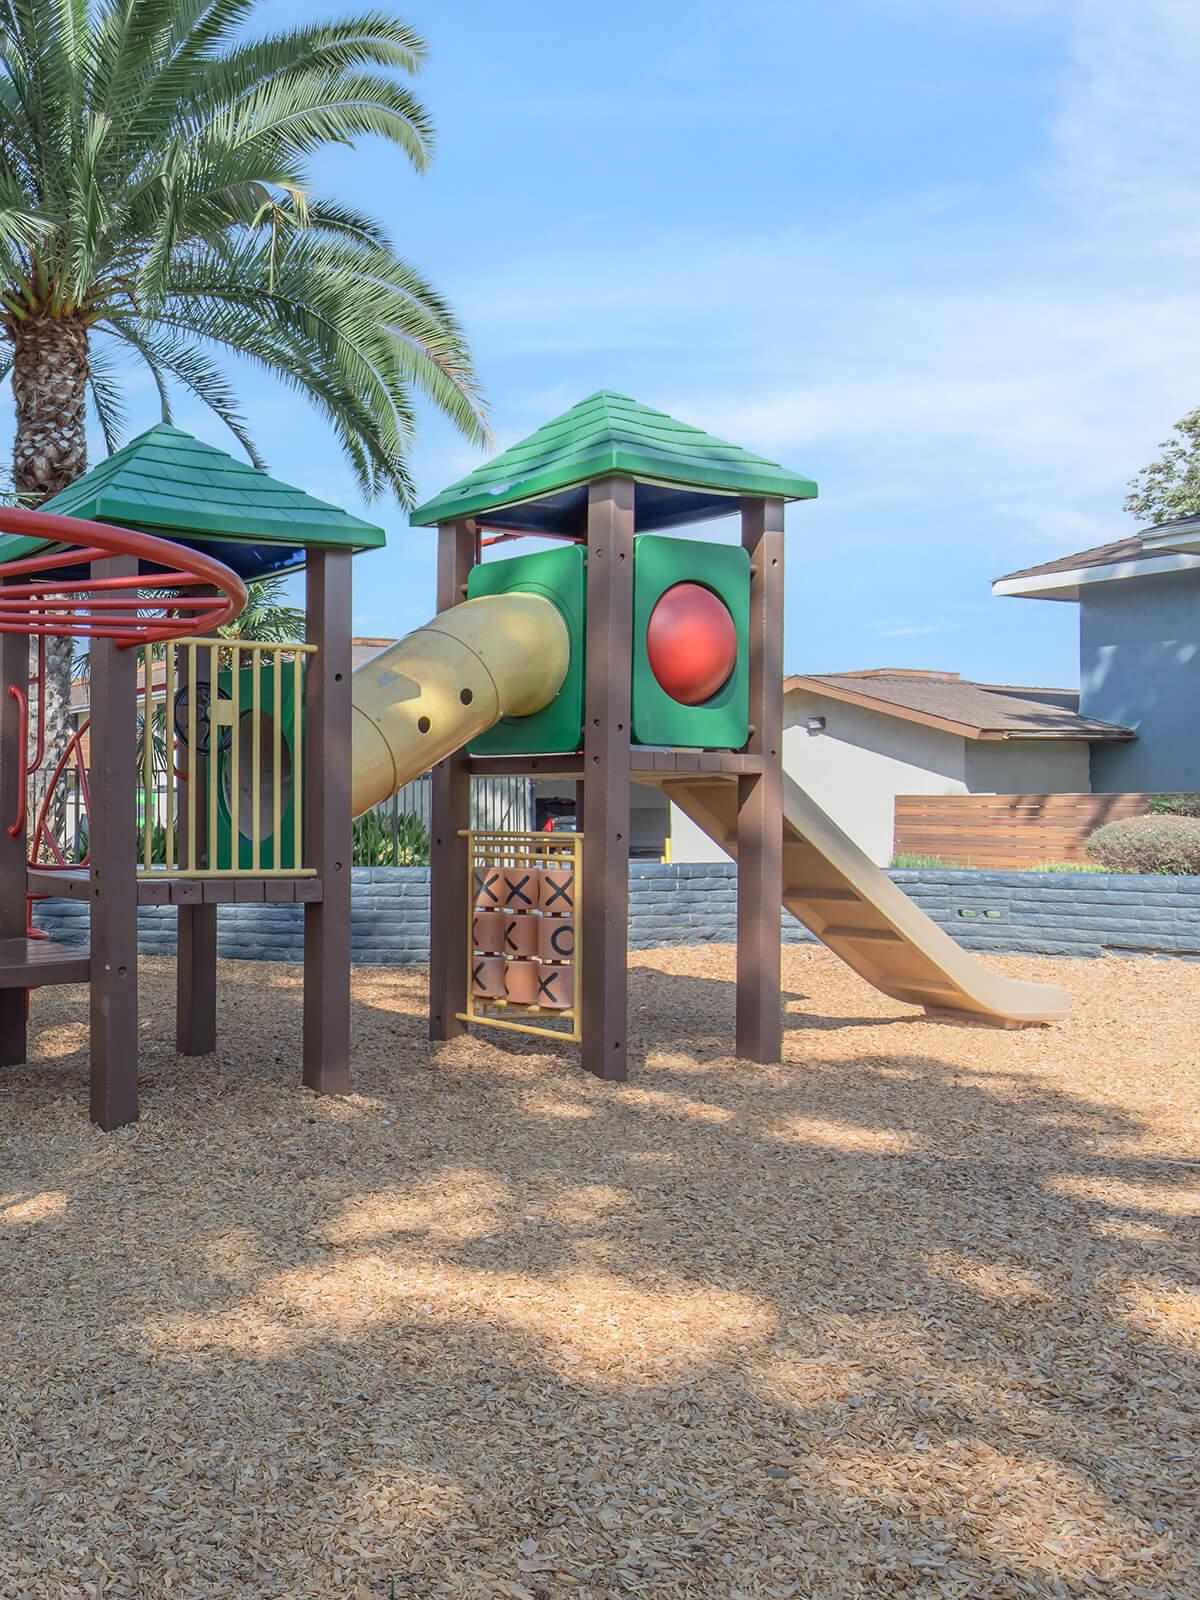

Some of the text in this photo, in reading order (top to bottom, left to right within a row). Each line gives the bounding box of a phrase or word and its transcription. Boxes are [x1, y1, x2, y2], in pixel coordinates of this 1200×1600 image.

[473, 873, 574, 907] X X X
